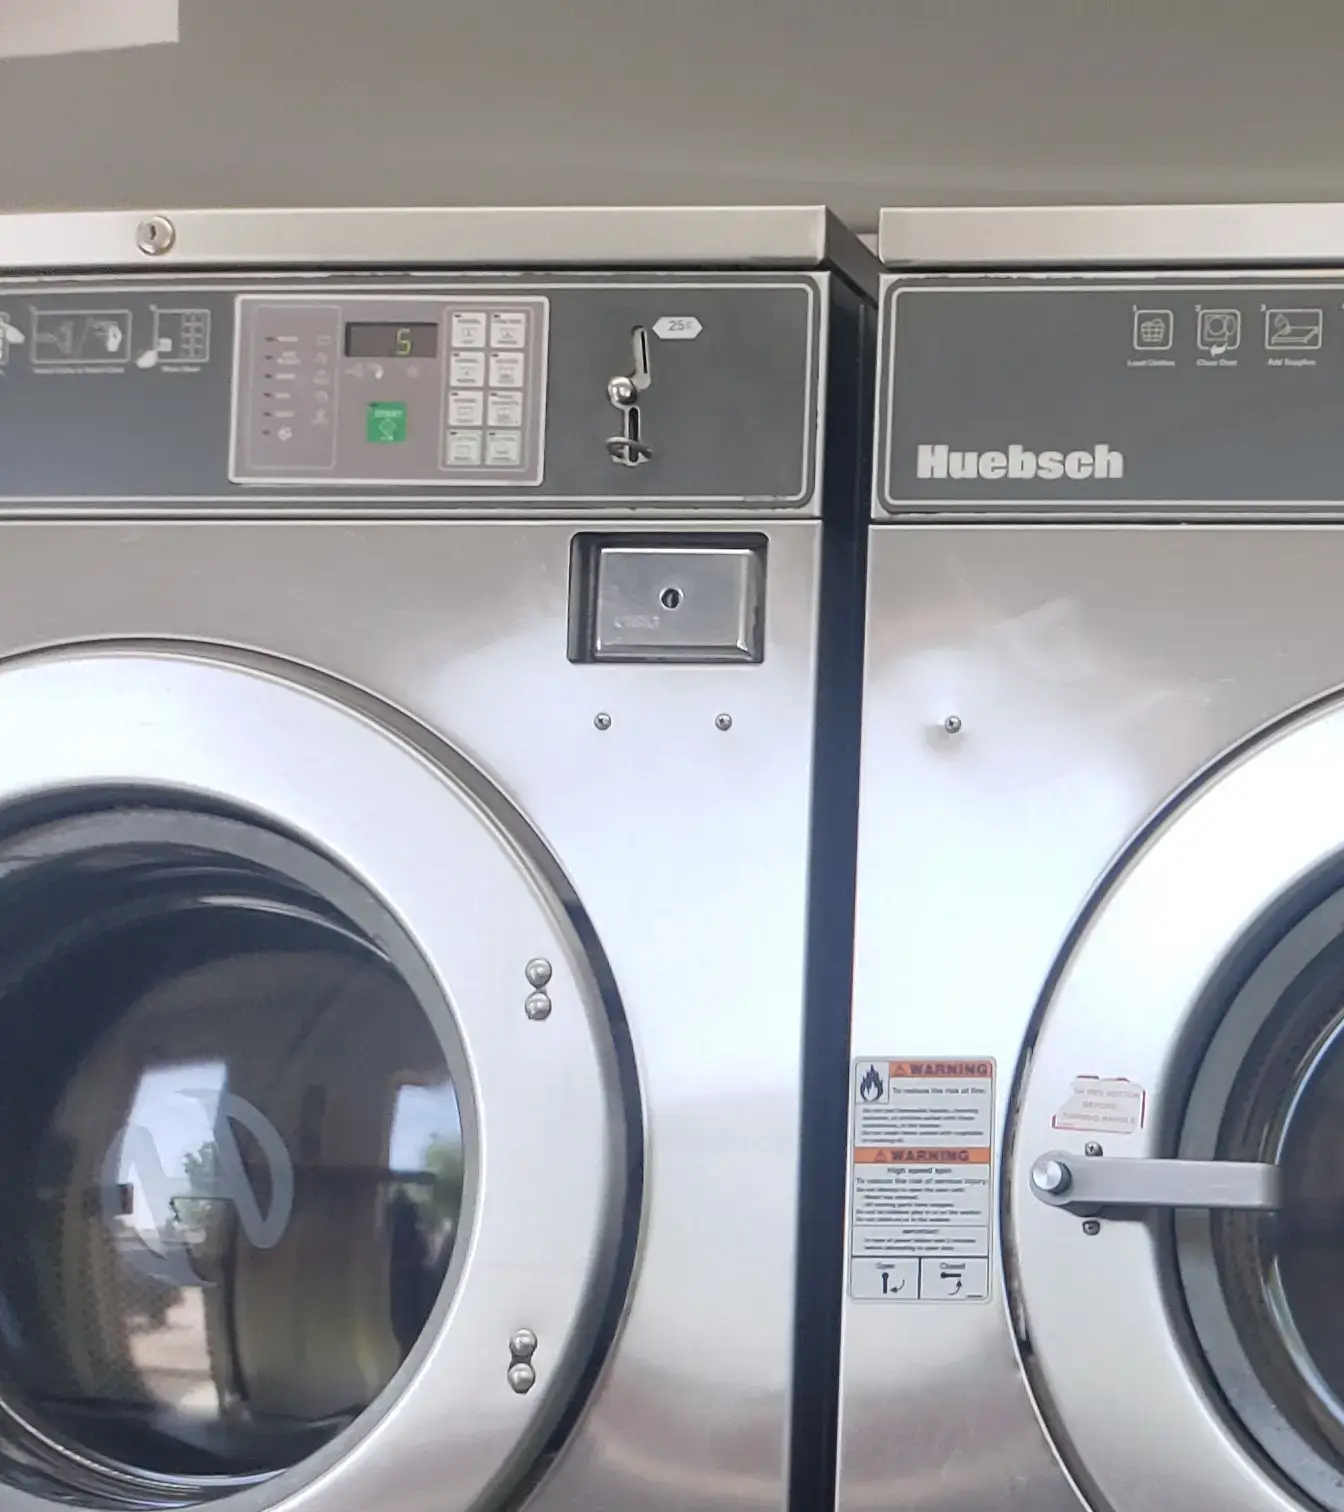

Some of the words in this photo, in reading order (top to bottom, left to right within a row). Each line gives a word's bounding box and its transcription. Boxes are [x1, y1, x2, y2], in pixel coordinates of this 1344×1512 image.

[395, 327, 412, 356] 5
[916, 444, 1124, 479] Huebsch
[909, 1063, 988, 1075] WARNING
[891, 1150, 970, 1161] WARNING
